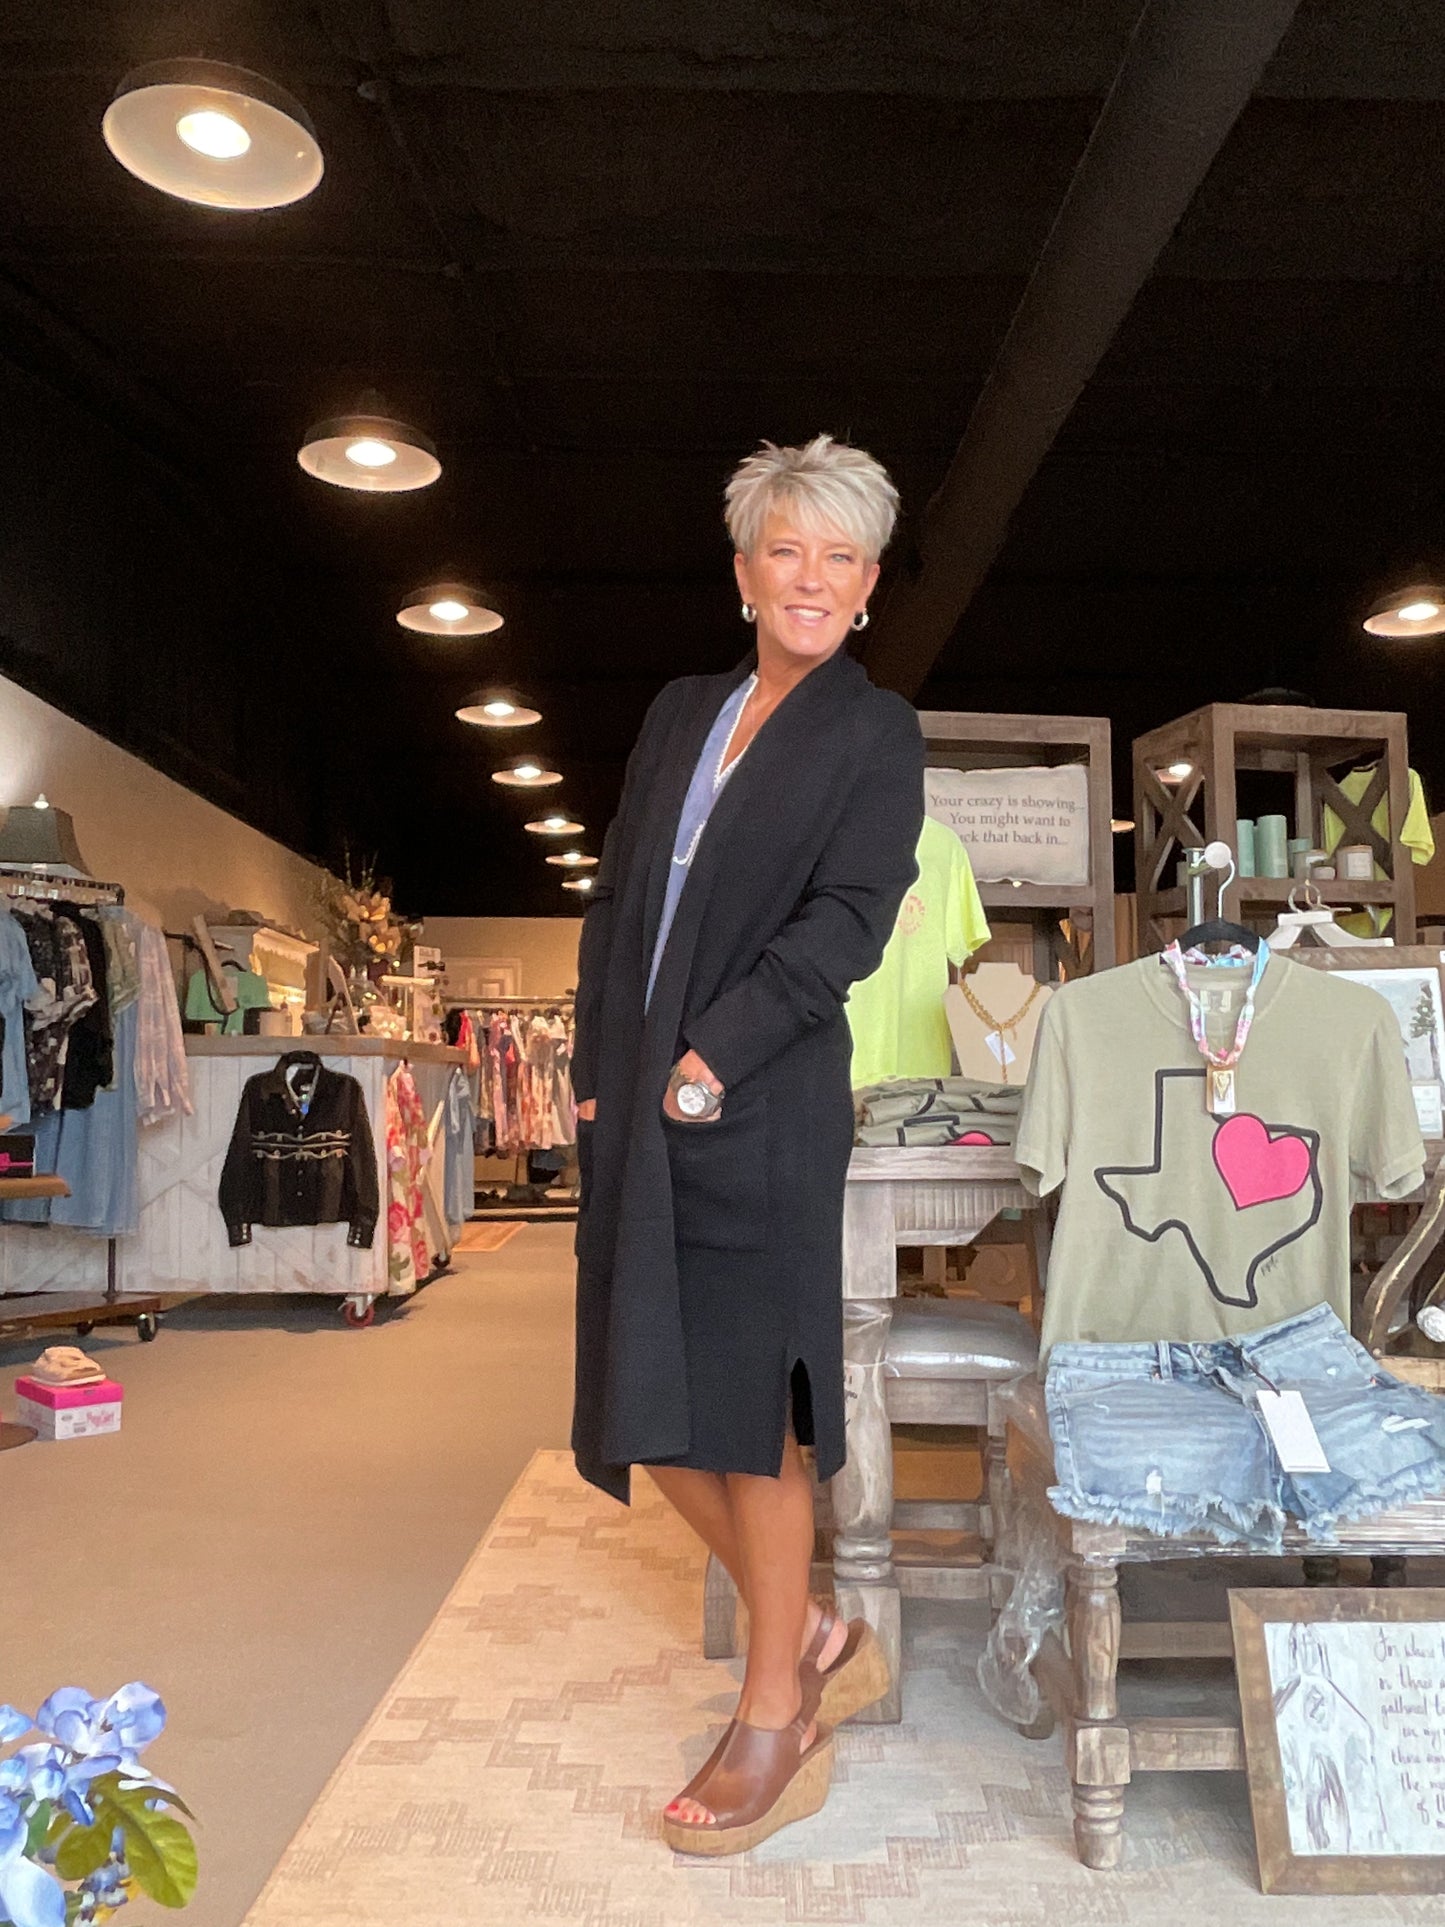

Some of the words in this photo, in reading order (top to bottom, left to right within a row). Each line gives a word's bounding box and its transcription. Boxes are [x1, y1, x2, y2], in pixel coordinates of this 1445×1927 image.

[930, 795, 963, 808] Your
[967, 796, 1003, 811] crazy
[1007, 795, 1019, 808] is
[950, 812, 976, 825] You
[980, 812, 1019, 828] might
[1023, 814, 1056, 827] want
[1059, 814, 1071, 828] to
[983, 831, 1008, 844] that
[1012, 831, 1042, 845] back
